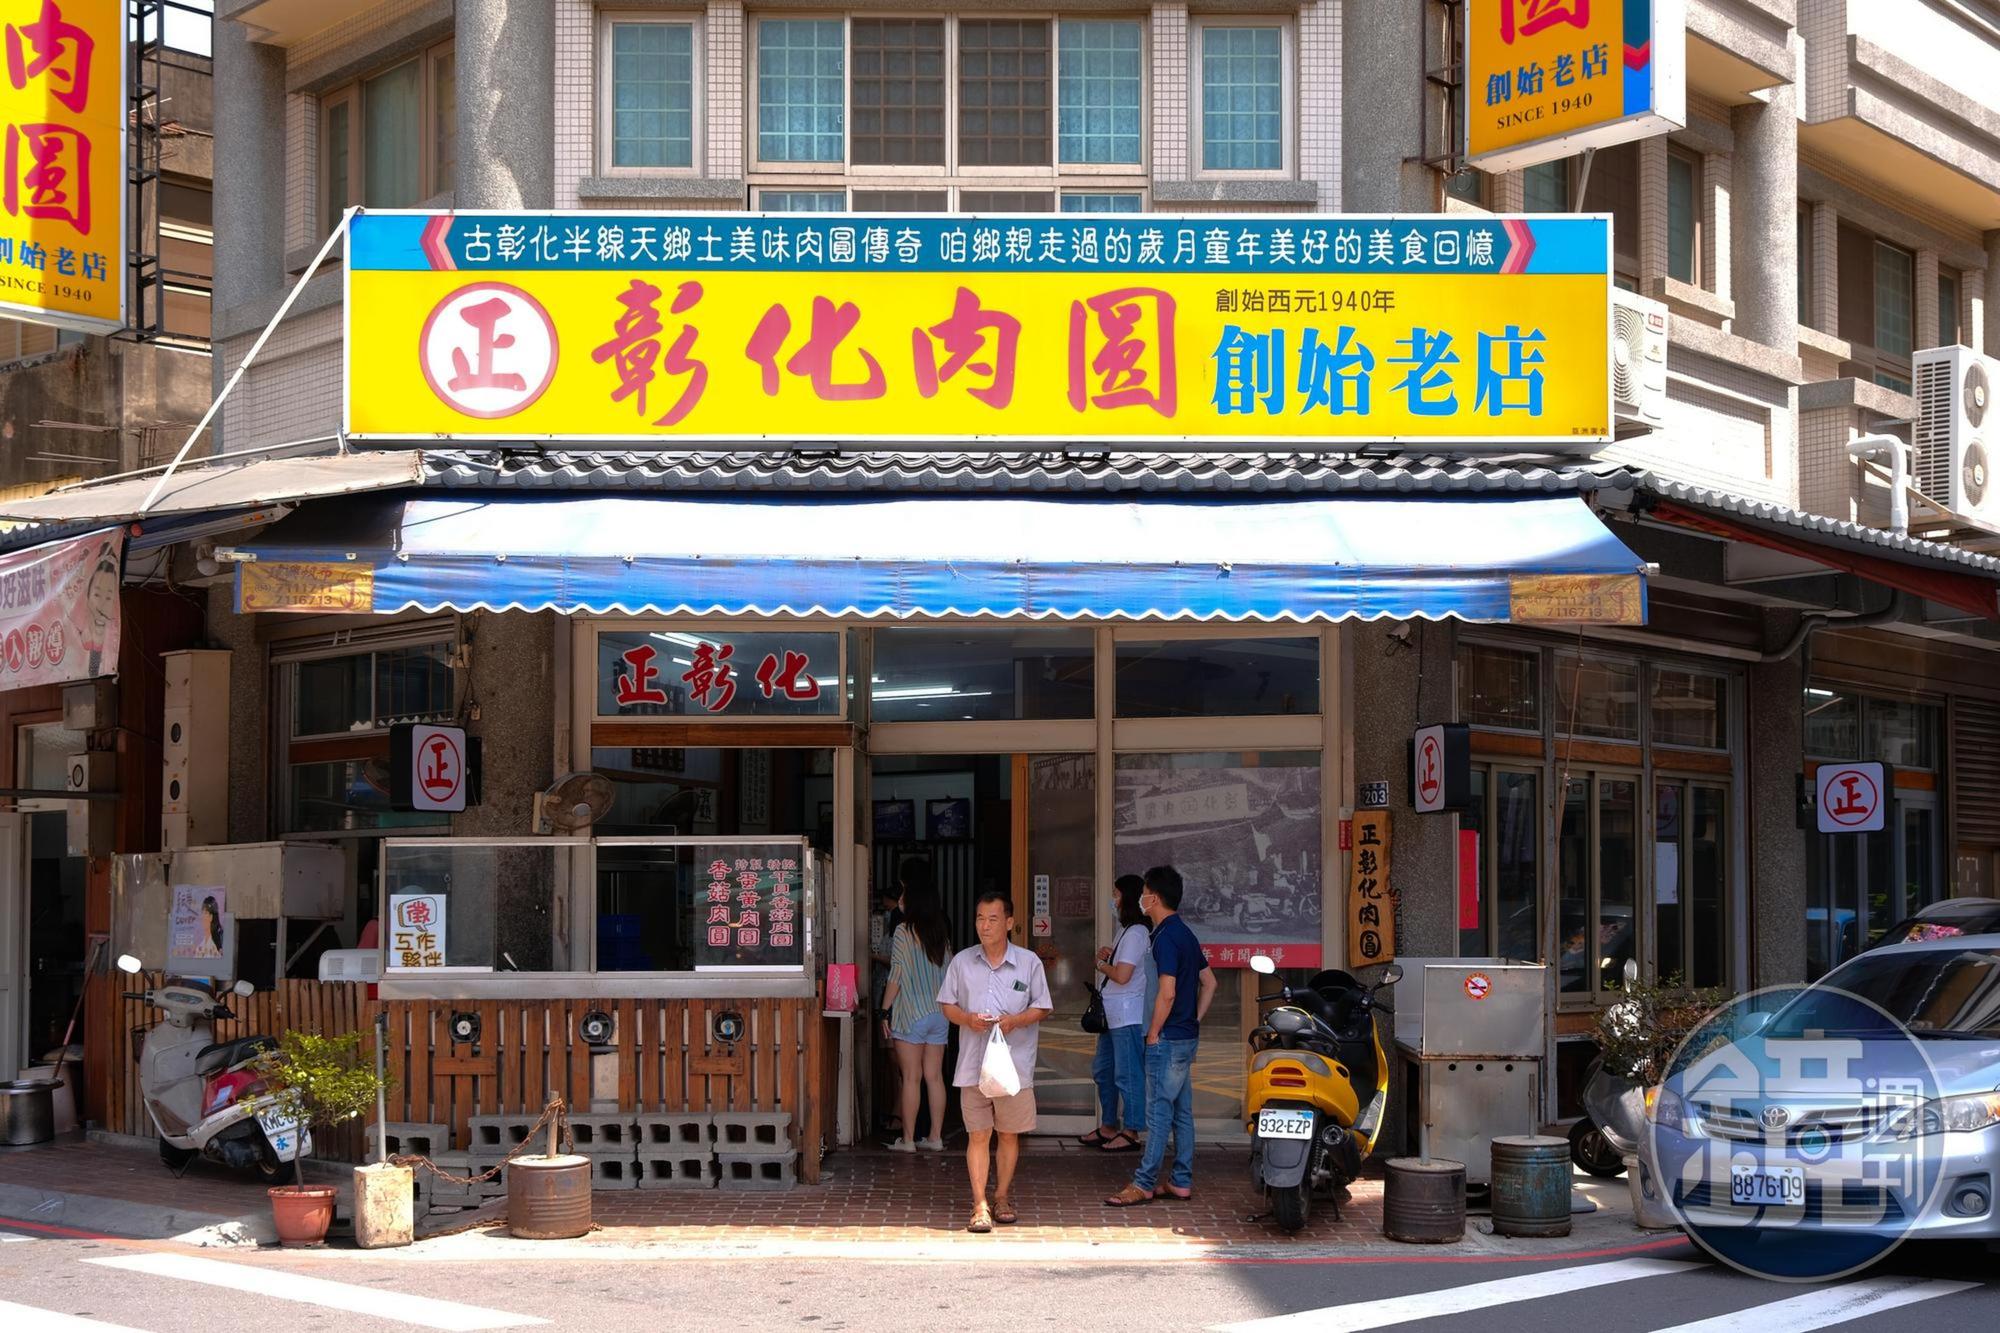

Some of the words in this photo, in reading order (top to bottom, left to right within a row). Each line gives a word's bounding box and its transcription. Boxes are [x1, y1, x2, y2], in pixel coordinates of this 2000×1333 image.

[1484, 43, 1609, 107] 創始老店
[1497, 106, 1544, 130] SINCE
[1552, 92, 1593, 116] 1940
[54, 284, 92, 302] 1940
[1215, 288, 1396, 314] 創始西元1940年
[447, 297, 527, 392] 正
[591, 278, 1178, 427] 彰化肉圓
[1210, 325, 1547, 418] 創始老店
[0, 565, 46, 610] 好滋味
[616, 641, 821, 713] 正彰化
[424, 742, 453, 790] 正
[1422, 744, 1438, 792] 正
[1365, 790, 1386, 804] 203
[1833, 777, 1869, 816] 正
[707, 859, 732, 946] 香菇肉圓
[736, 872, 761, 946] 蛋黃肉圓
[1358, 823, 1382, 959] 正彰化肉圓
